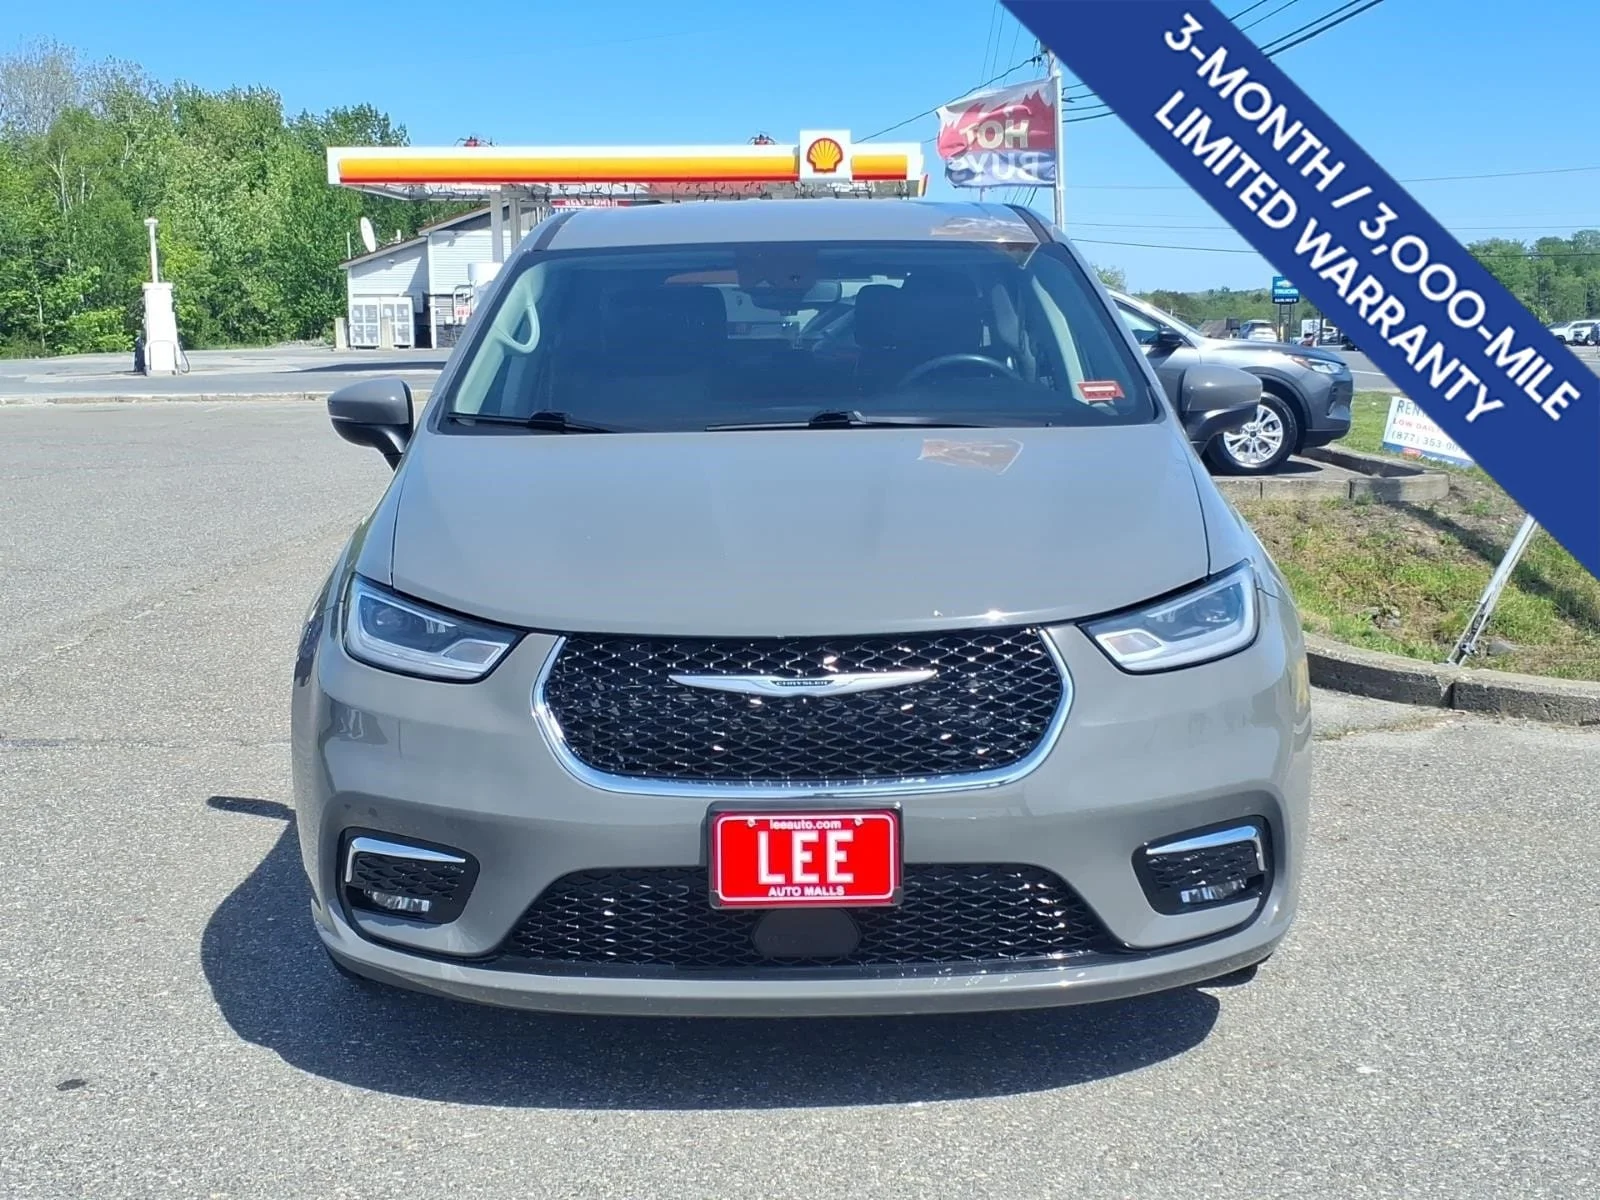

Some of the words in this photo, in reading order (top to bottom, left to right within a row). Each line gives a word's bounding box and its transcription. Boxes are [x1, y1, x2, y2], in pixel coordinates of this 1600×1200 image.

[769, 818, 842, 830] leeauto.com
[757, 829, 854, 885] LEE
[768, 886, 802, 897] AUTO
[804, 886, 845, 897] MALLS
